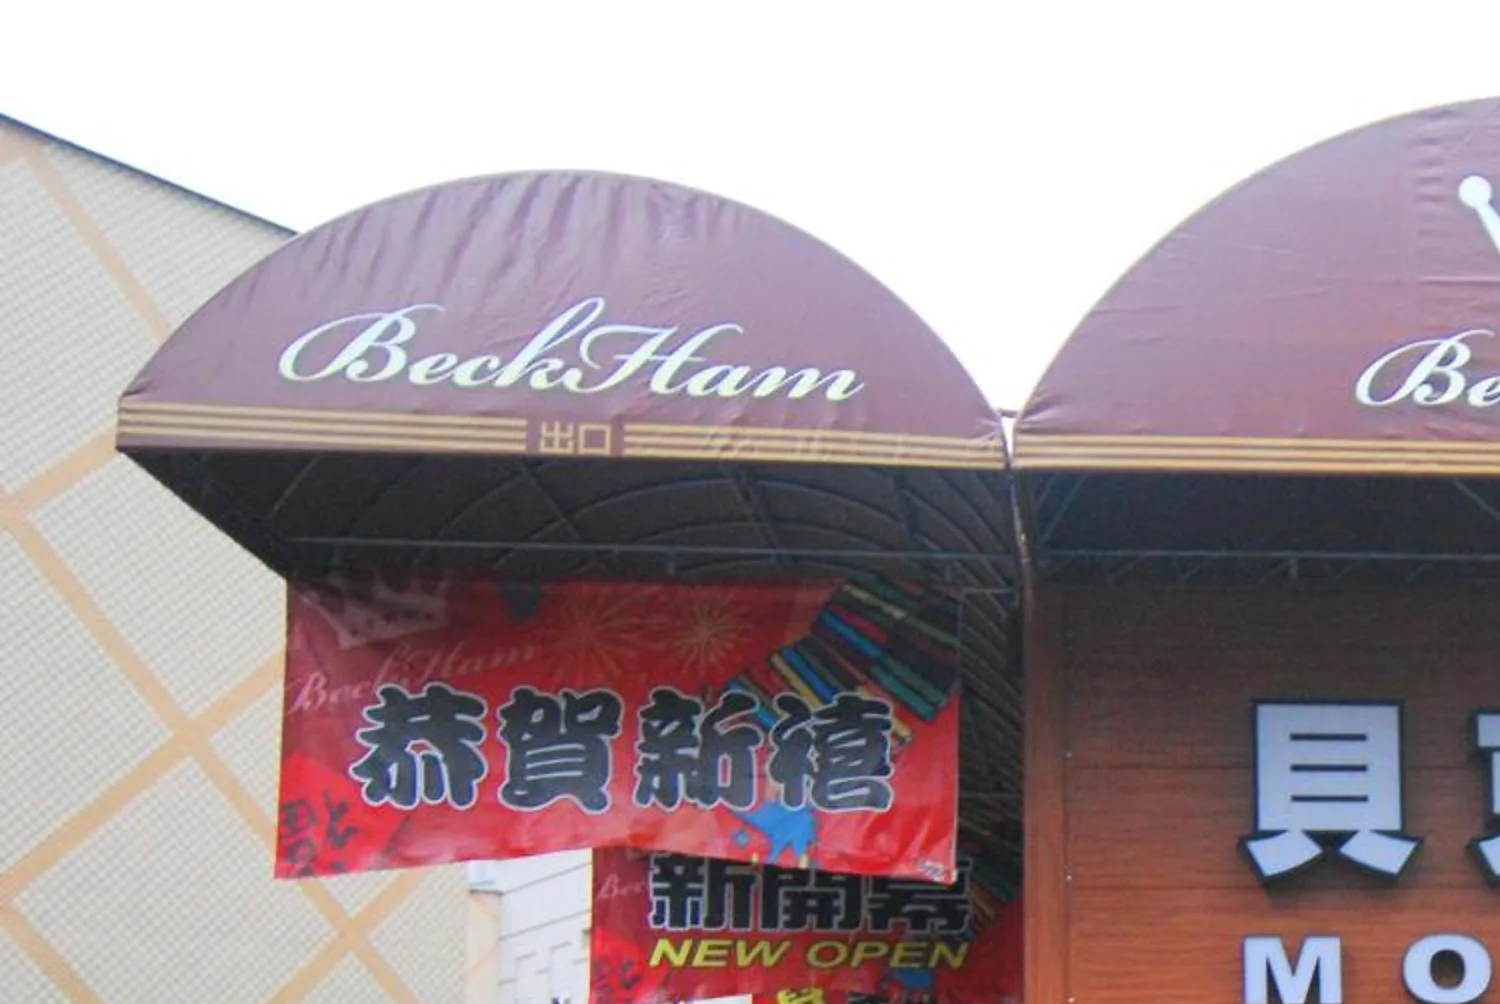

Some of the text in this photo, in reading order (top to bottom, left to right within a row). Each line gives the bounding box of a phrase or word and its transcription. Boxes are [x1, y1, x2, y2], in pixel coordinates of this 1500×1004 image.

[278, 296, 865, 402] BeckHam
[541, 421, 612, 455] 出口
[350, 682, 895, 813] 恭賀新禧
[648, 853, 973, 934] 新開幕
[648, 939, 970, 969] NEW OPEN
